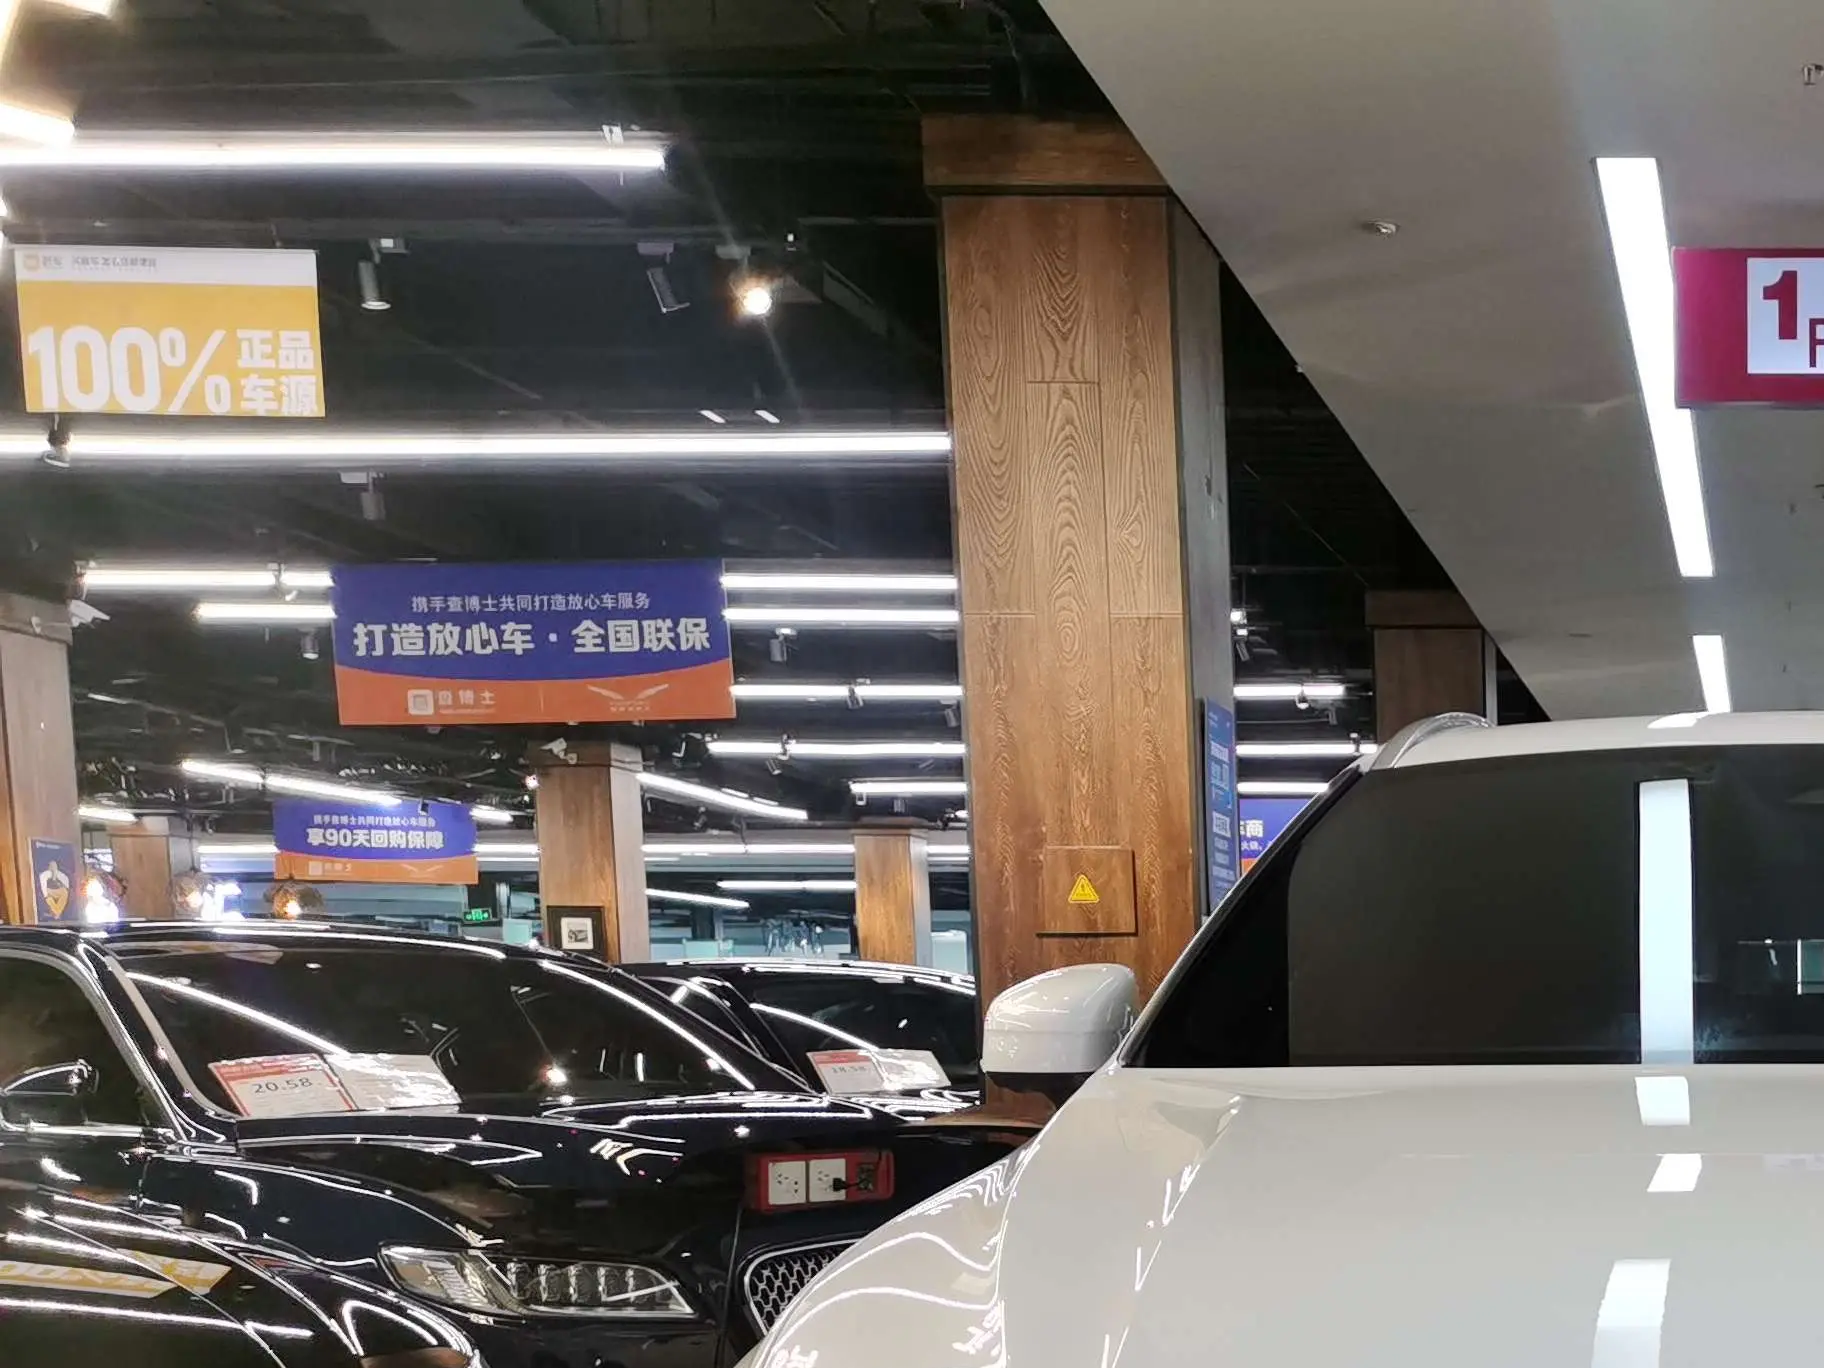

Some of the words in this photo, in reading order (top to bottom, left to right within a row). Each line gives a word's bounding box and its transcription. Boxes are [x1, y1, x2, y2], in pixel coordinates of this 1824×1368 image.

[236, 329, 314, 369] 正品
[28, 325, 231, 413] 100%
[240, 374, 317, 415] 车源
[411, 592, 650, 613] 携手查博士共同打造放心车服务
[306, 828, 443, 850] 享90天回购保障
[253, 1077, 313, 1094] 20.58
